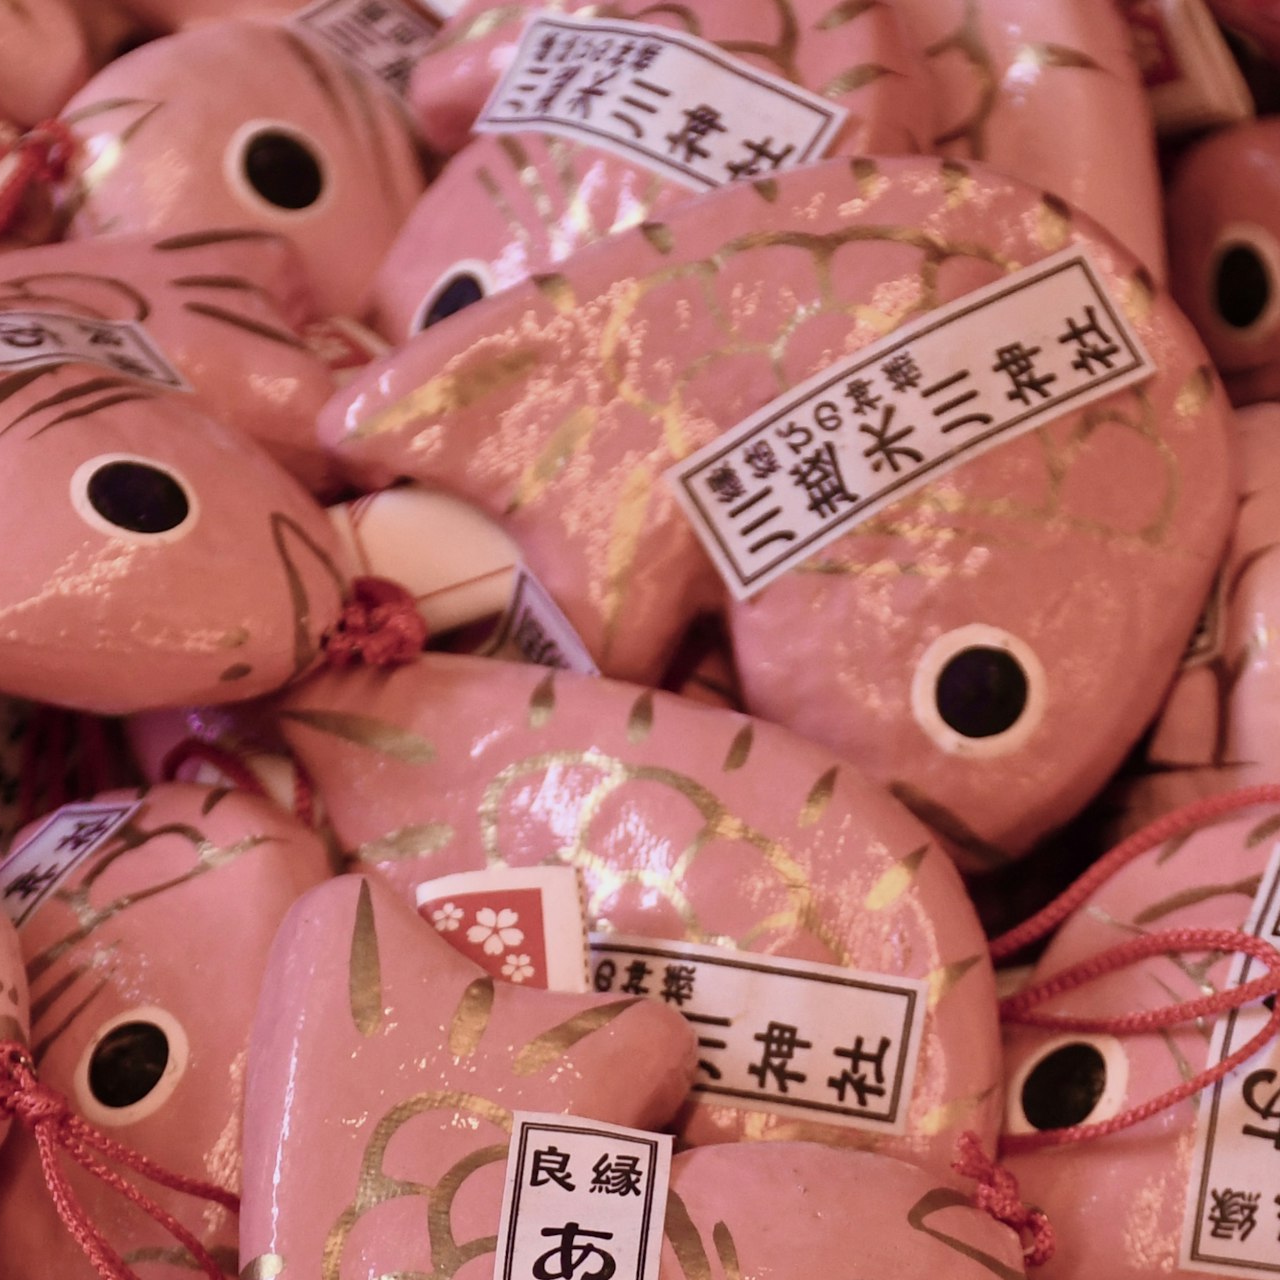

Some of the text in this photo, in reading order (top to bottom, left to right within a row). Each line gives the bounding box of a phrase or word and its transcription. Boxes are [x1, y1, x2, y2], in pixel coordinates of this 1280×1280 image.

[715, 350, 926, 505] 縁結びの神様
[728, 304, 1122, 556] 川越氷川神社
[528, 1146, 642, 1198] 良縁
